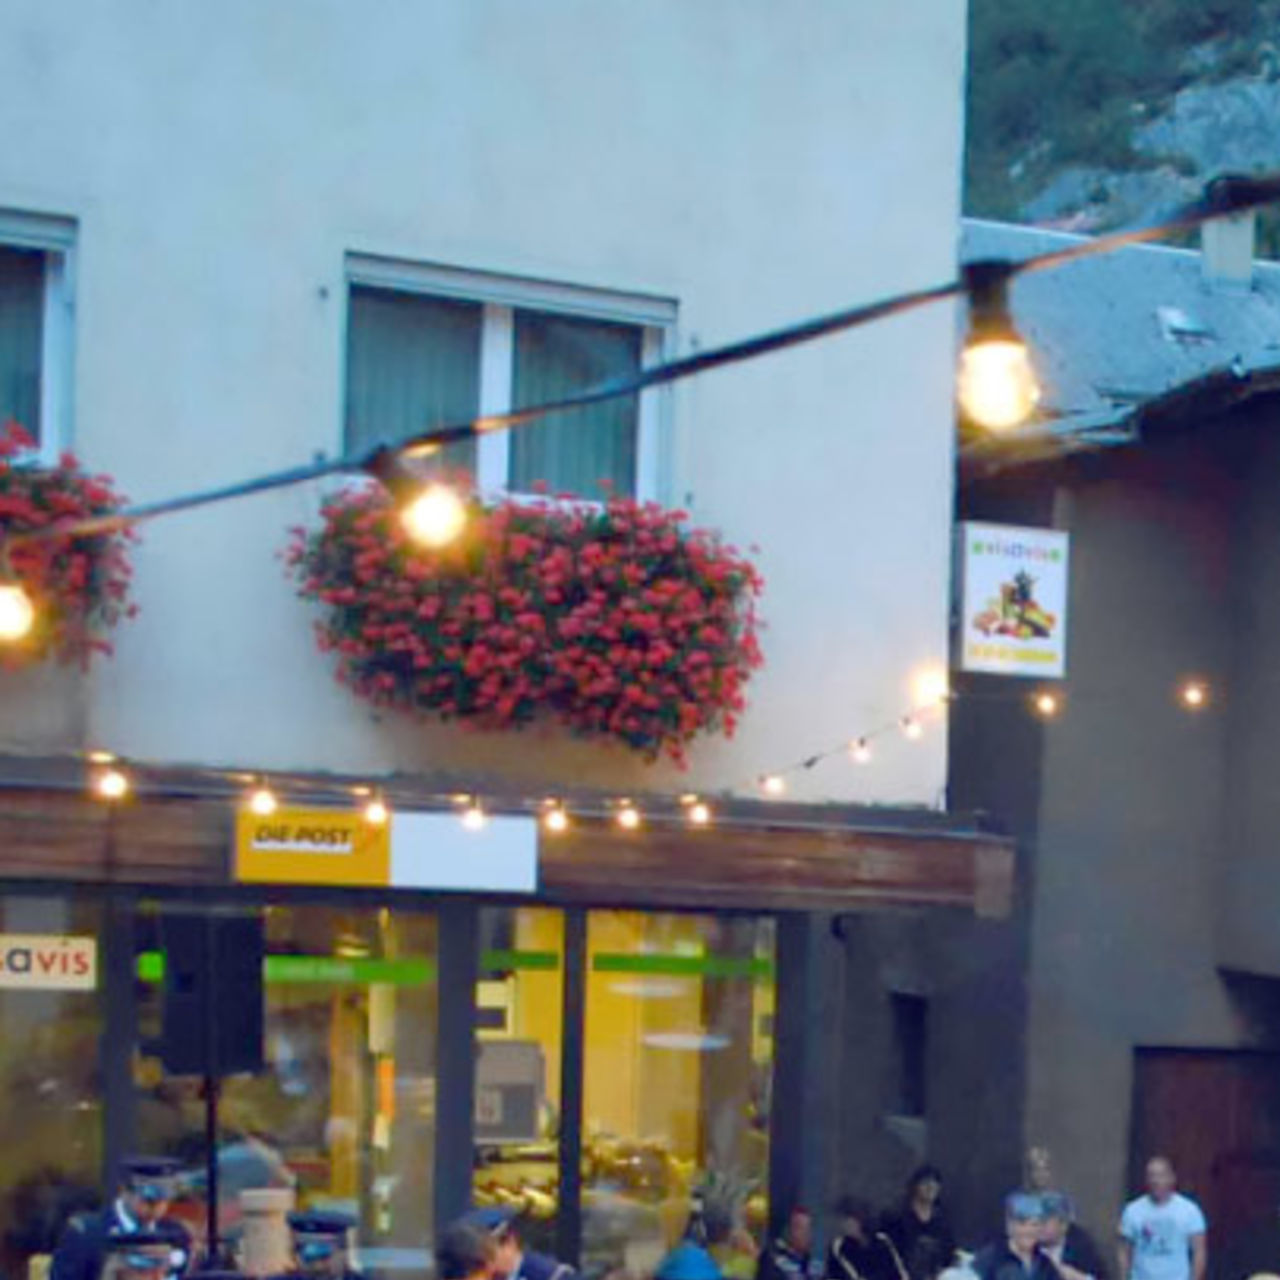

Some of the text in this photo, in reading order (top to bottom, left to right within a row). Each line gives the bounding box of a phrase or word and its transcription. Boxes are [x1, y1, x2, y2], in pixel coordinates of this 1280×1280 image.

[254, 823, 352, 847] DIE POST
[0, 940, 90, 975] avis
